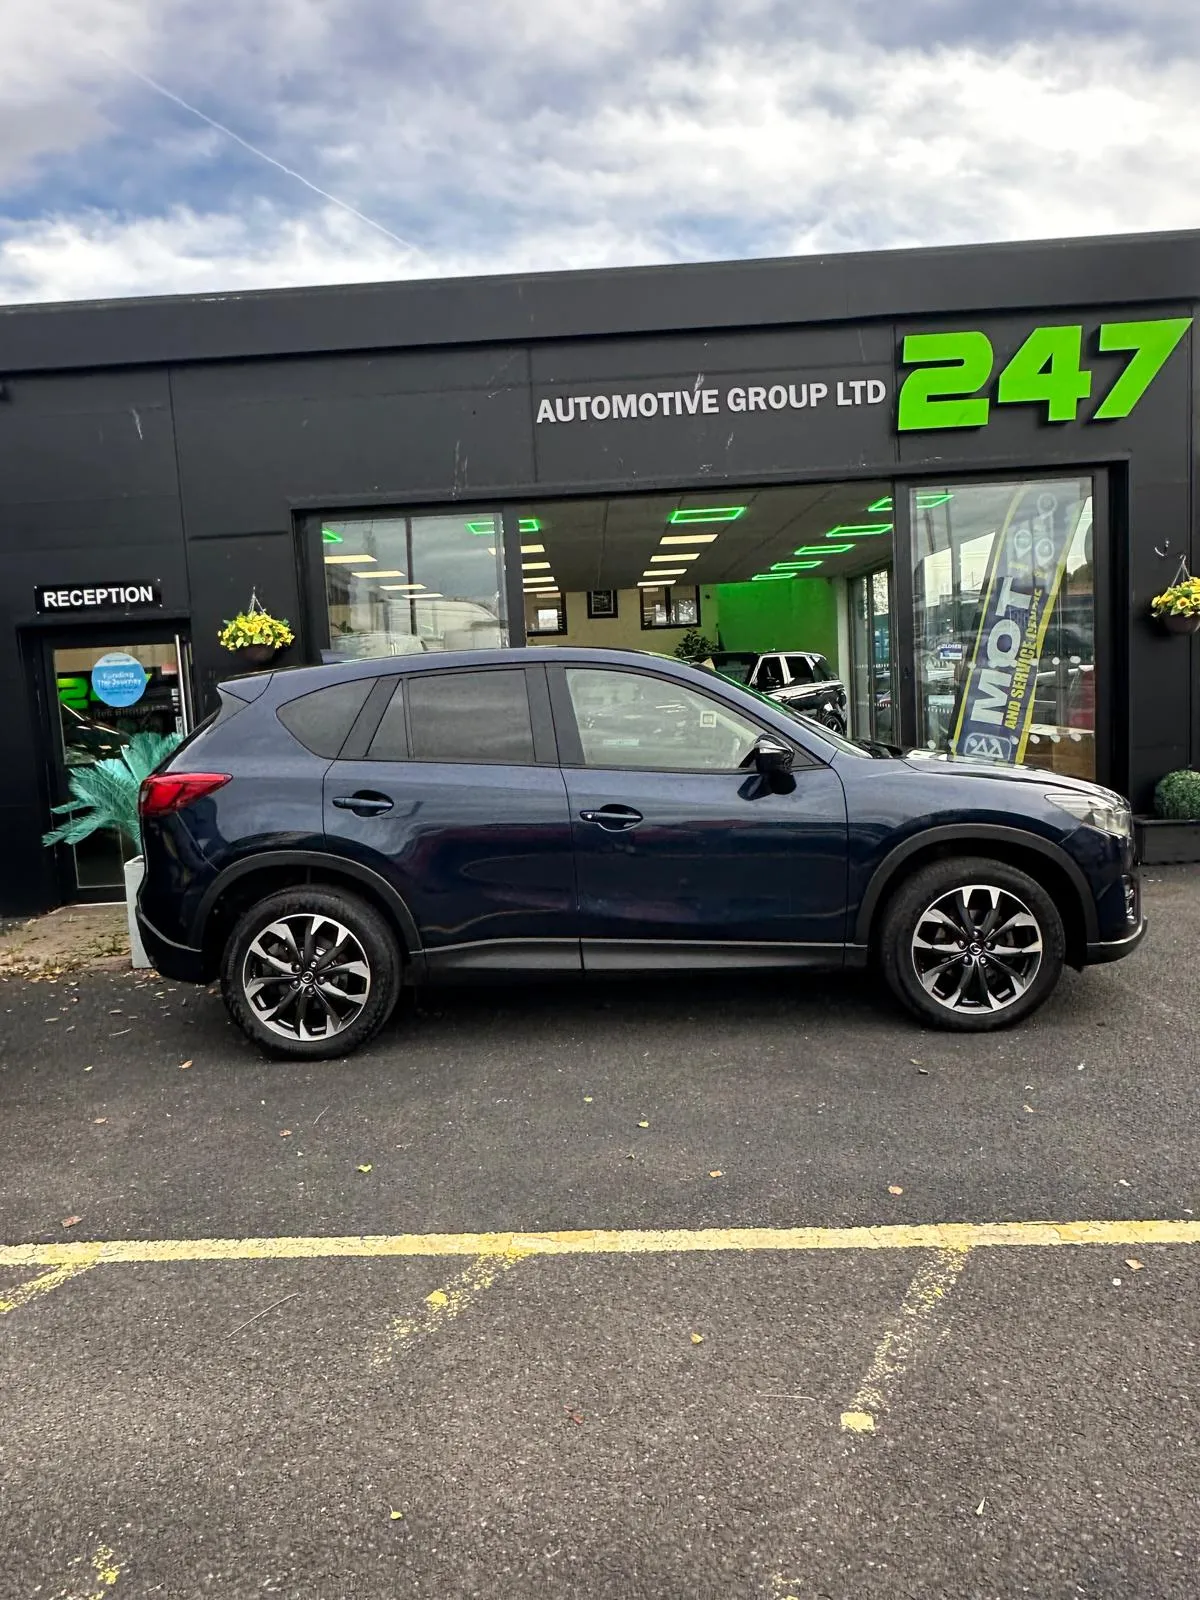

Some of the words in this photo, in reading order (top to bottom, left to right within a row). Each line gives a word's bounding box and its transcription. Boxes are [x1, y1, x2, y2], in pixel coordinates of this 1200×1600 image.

[898, 317, 1194, 431] 247
[536, 389, 719, 424] AUTOMOTIVE
[727, 382, 828, 413] GROUP
[836, 379, 887, 406] LTD
[43, 586, 154, 608] RECEPTION
[970, 576, 1032, 725] MOT
[1010, 641, 1037, 699] SERVICE
[1004, 700, 1022, 729] AND
